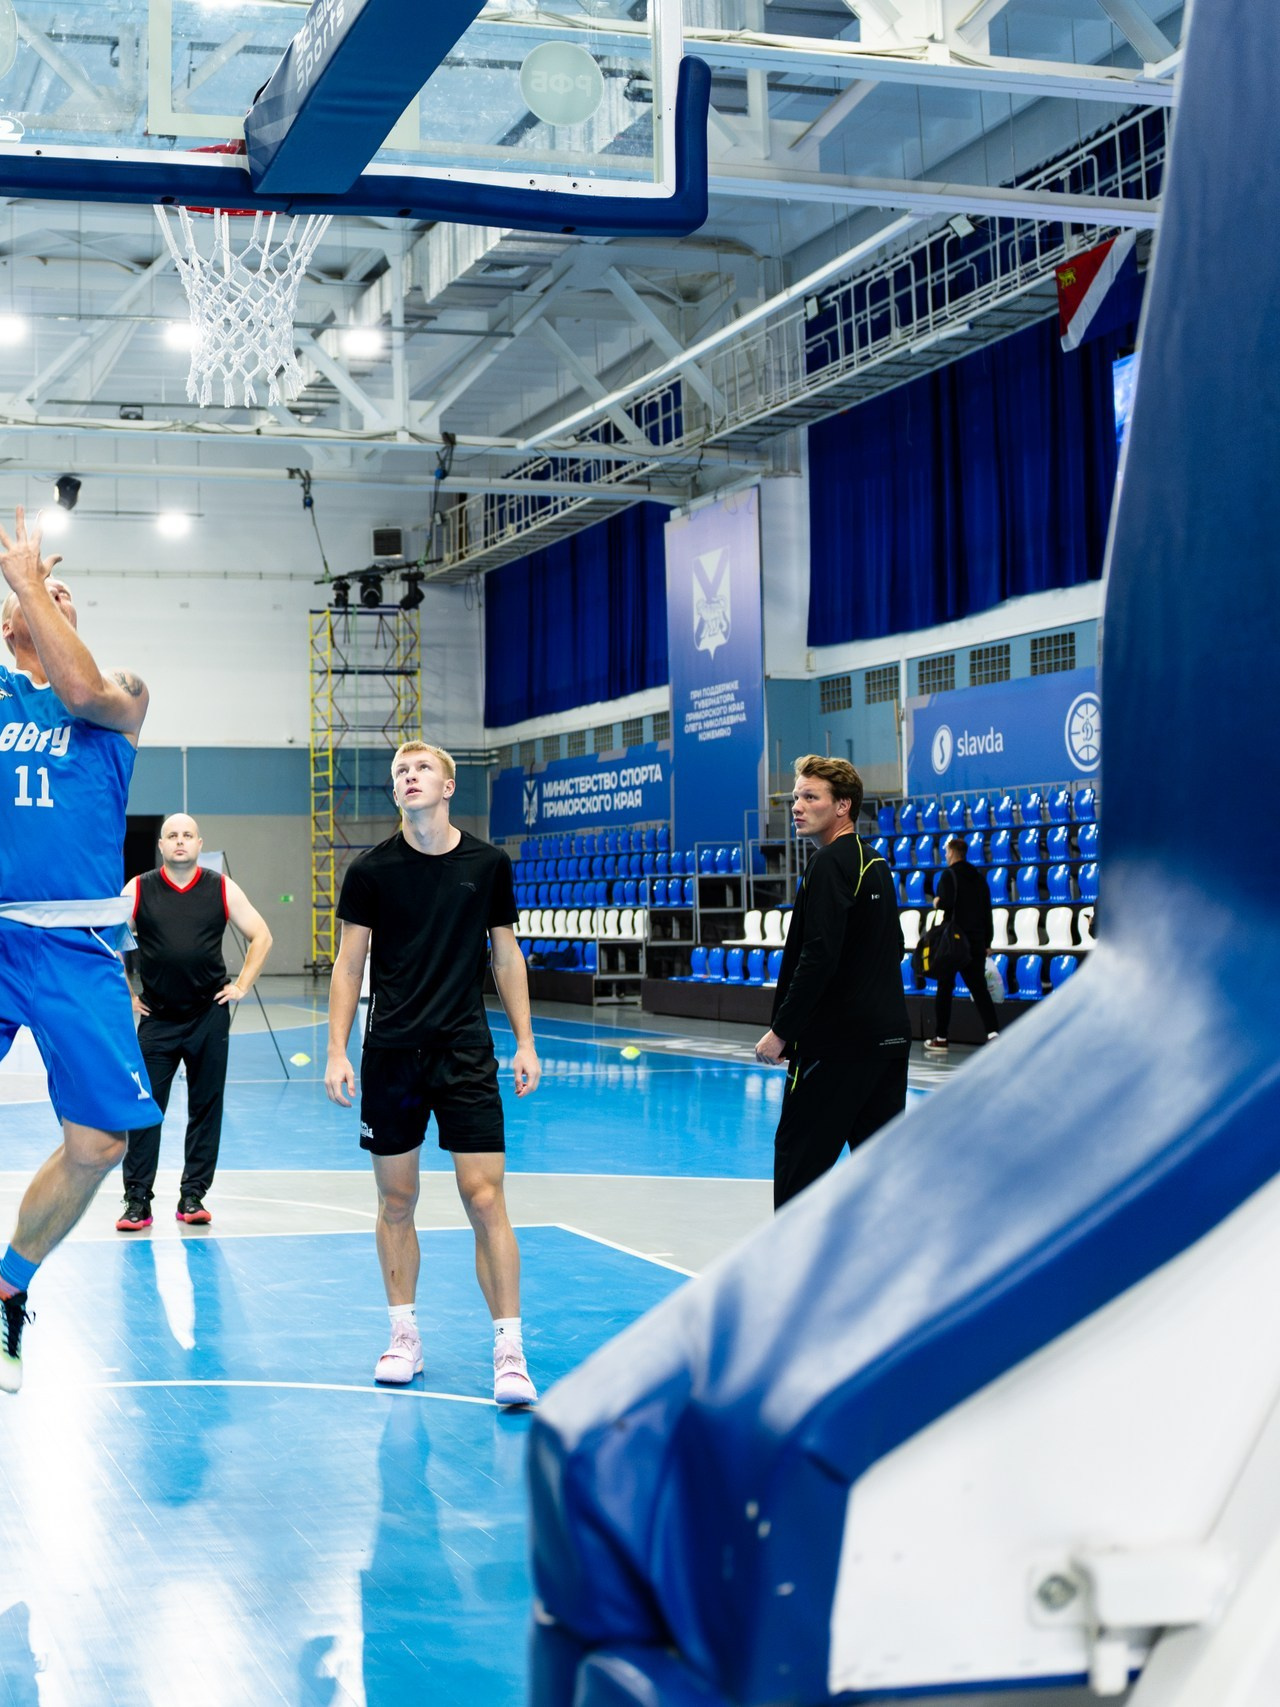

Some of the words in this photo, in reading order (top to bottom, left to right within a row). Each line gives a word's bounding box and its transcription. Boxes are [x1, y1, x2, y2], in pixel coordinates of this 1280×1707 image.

[690, 689, 702, 700] ПРИ
[702, 680, 739, 697] ПОДДЕРЖКЕ
[694, 692, 735, 710] ГУБЕРНАТОРА
[686, 705, 728, 722] ПРИМОРСКОГО
[957, 726, 1004, 757] slavda
[14, 765, 54, 808] 11
[542, 771, 618, 799] МИНИСТЕРСТВО
[619, 763, 663, 788] СПОРТА
[542, 793, 612, 819] ПРИМОРСКОГО
[613, 789, 642, 811] КРАЯ
